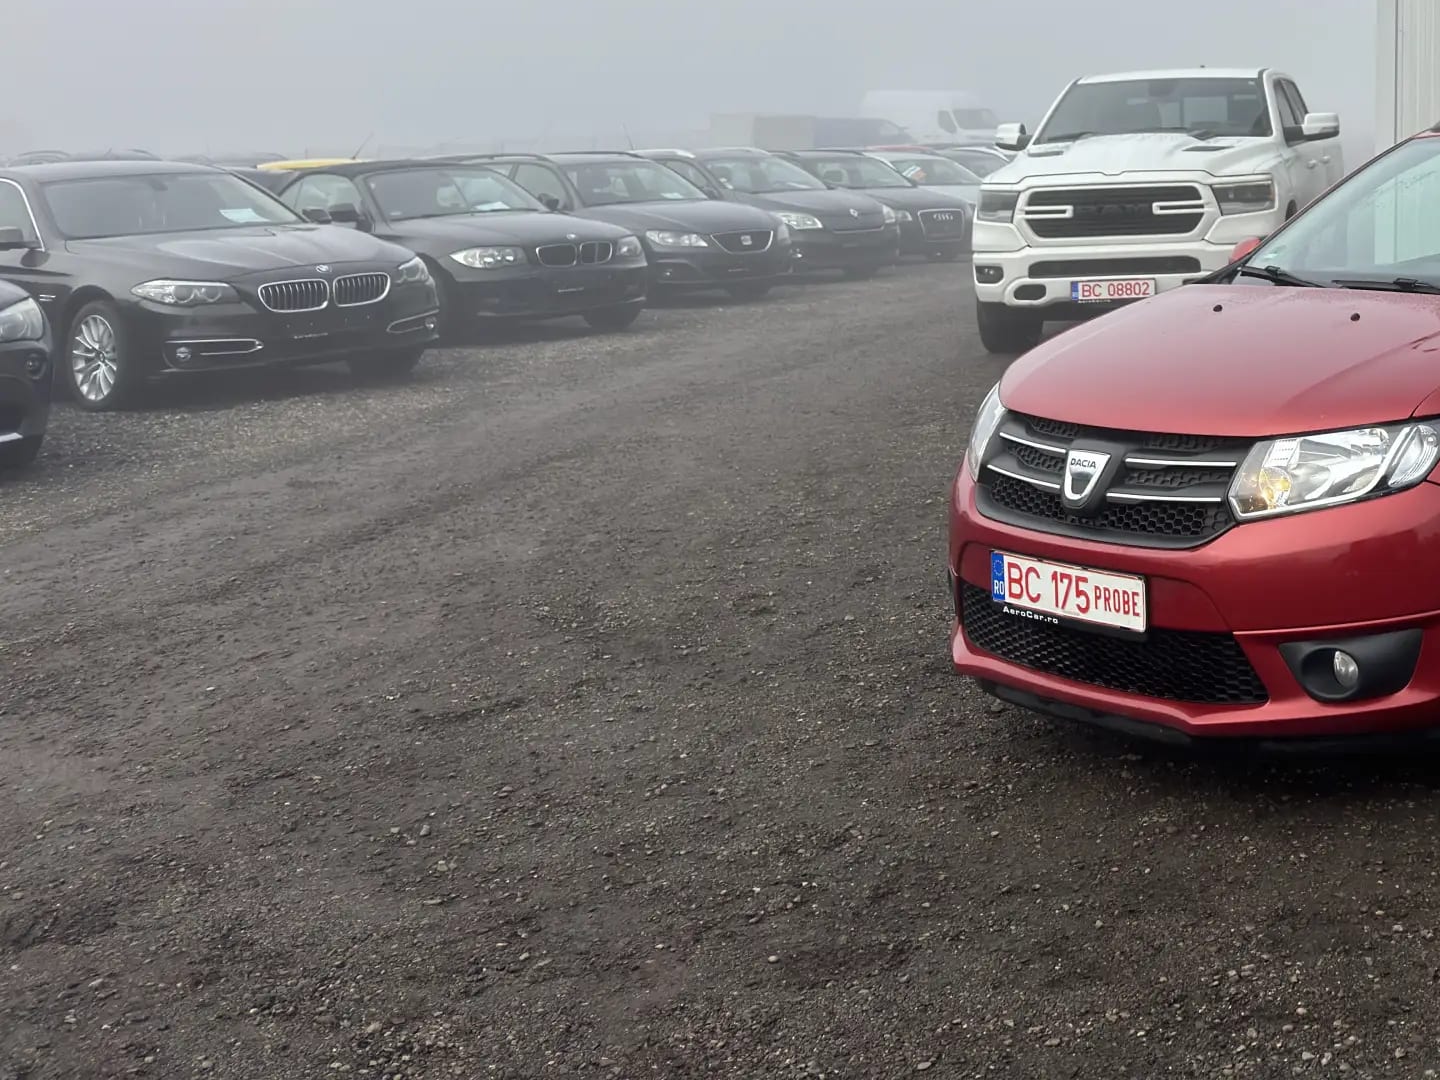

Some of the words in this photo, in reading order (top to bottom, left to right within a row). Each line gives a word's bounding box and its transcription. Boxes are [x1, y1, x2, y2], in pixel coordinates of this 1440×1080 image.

[1081, 283, 1102, 298] BC
[1107, 282, 1150, 297] 08802
[1070, 458, 1097, 469] DACIA
[994, 579, 1005, 595] RO
[1007, 561, 1042, 604] BC
[1051, 570, 1091, 614] 175
[1094, 585, 1140, 616] PROBE
[1003, 605, 1059, 624] AeroCar.ro
